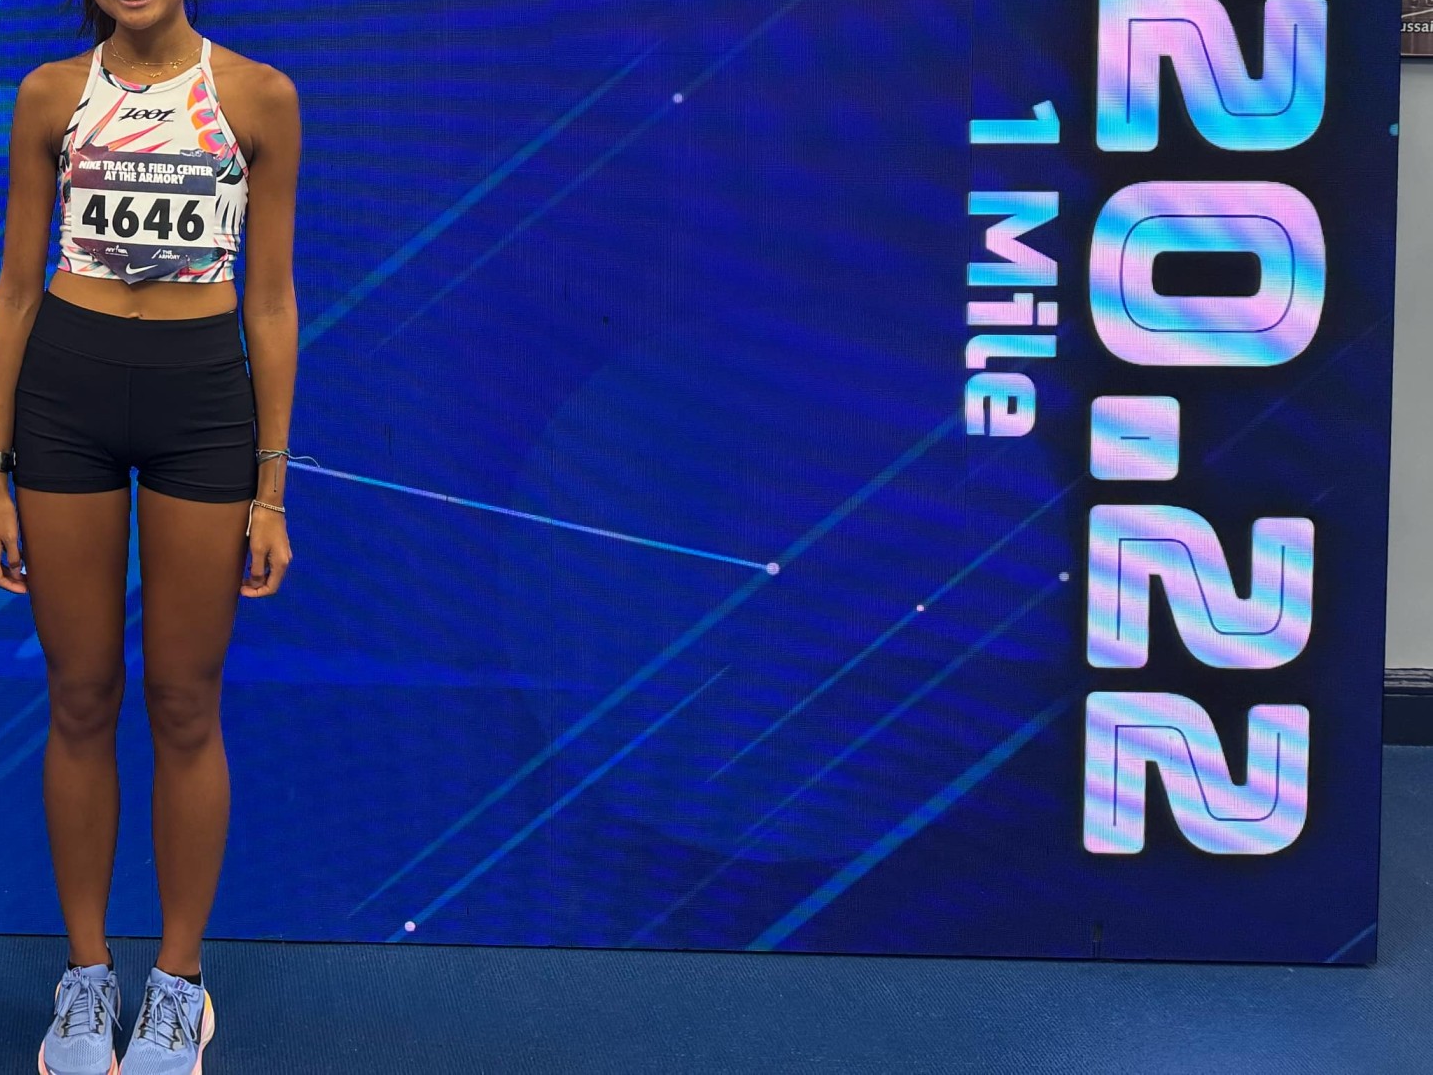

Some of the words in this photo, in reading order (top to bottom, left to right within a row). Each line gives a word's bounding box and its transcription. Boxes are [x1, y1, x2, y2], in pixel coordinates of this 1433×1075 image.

[969, 99, 1061, 145] 1
[79, 161, 101, 170] NIKE
[103, 161, 135, 172] TRACK
[137, 162, 146, 173] &
[148, 163, 175, 174] FIELD
[177, 164, 213, 177] CENTER
[104, 170, 118, 181] AT
[119, 171, 137, 182] THE
[138, 172, 185, 185] ARMORY
[81, 193, 205, 241] 4646
[964, 190, 1059, 437] Mile
